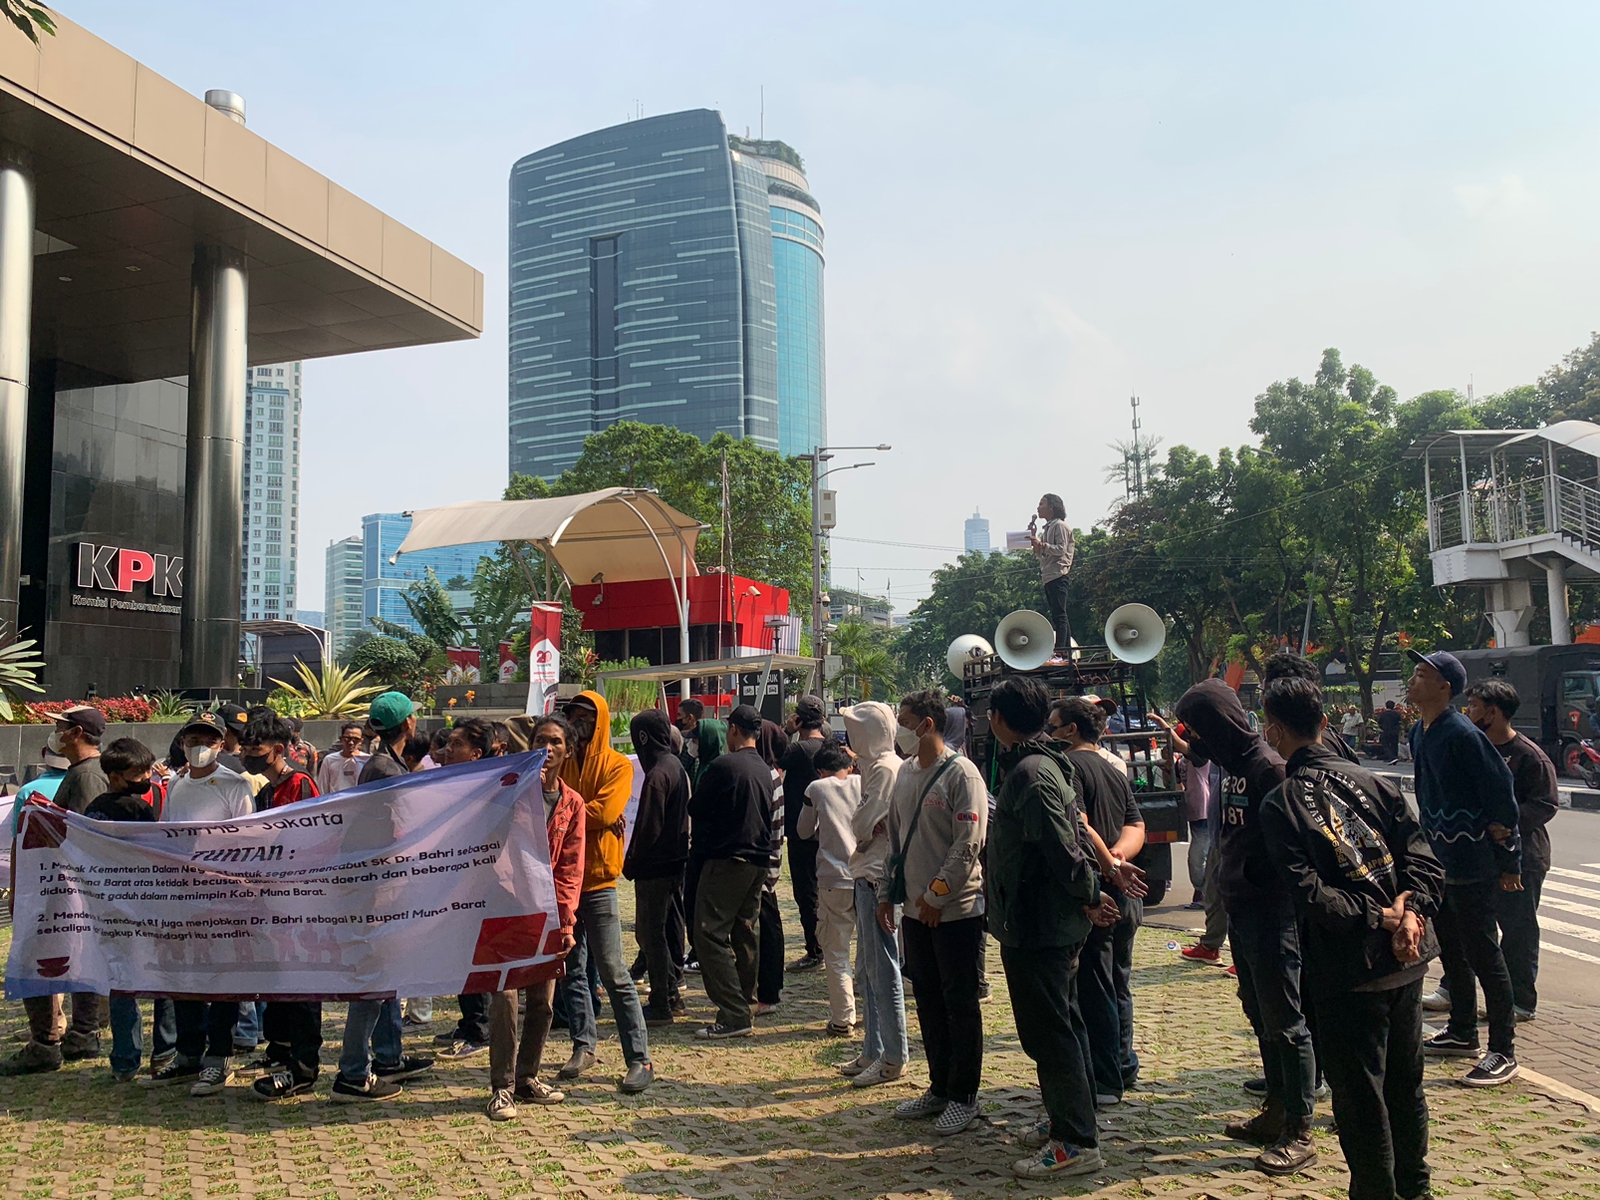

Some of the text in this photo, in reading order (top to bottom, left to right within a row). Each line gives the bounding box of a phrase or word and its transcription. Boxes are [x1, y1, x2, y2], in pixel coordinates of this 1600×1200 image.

[78, 542, 184, 598] KPK
[72, 594, 108, 608] Komisi
[757, 673, 779, 683] MSUK
[262, 812, 343, 830] Jakarta
[39, 862, 48, 871] 1.
[88, 865, 150, 874] Kementerian
[152, 865, 179, 873] Dalam
[230, 869, 262, 878] untuk
[265, 868, 306, 879] segera
[308, 859, 368, 874] mencabut
[371, 857, 391, 867] SK
[394, 855, 415, 864] Dr.
[419, 848, 454, 861] Bahri
[457, 841, 501, 857] sebagai
[40, 874, 54, 884] PJ
[103, 878, 131, 887] Barat
[134, 879, 154, 887] atas
[155, 878, 189, 887] ketidak
[193, 878, 242, 887] becusan
[331, 873, 378, 885] daerah
[381, 869, 408, 879] dan
[412, 862, 470, 877] beberapa
[473, 855, 497, 867] kali
[40, 886, 77, 897] diduga
[108, 891, 138, 902] gaduh
[140, 892, 168, 901] dalam
[170, 890, 227, 902] memimpin
[229, 889, 257, 899] Kab.
[260, 888, 290, 898] Muna
[293, 887, 327, 897] Barat.
[38, 914, 49, 922] 2.
[147, 919, 158, 928] RI
[161, 919, 183, 929] juga
[250, 917, 268, 926] Dr.
[272, 915, 303, 925] Bahri
[305, 913, 348, 926] sebagai
[350, 915, 363, 925] PJ
[366, 911, 410, 925] Bupati
[412, 906, 449, 919] Muna
[451, 899, 487, 911] Barat
[37, 924, 91, 936] sekaligus
[135, 929, 193, 942] Kemendagri
[194, 931, 208, 940] itu
[211, 929, 254, 940] sendiri.
